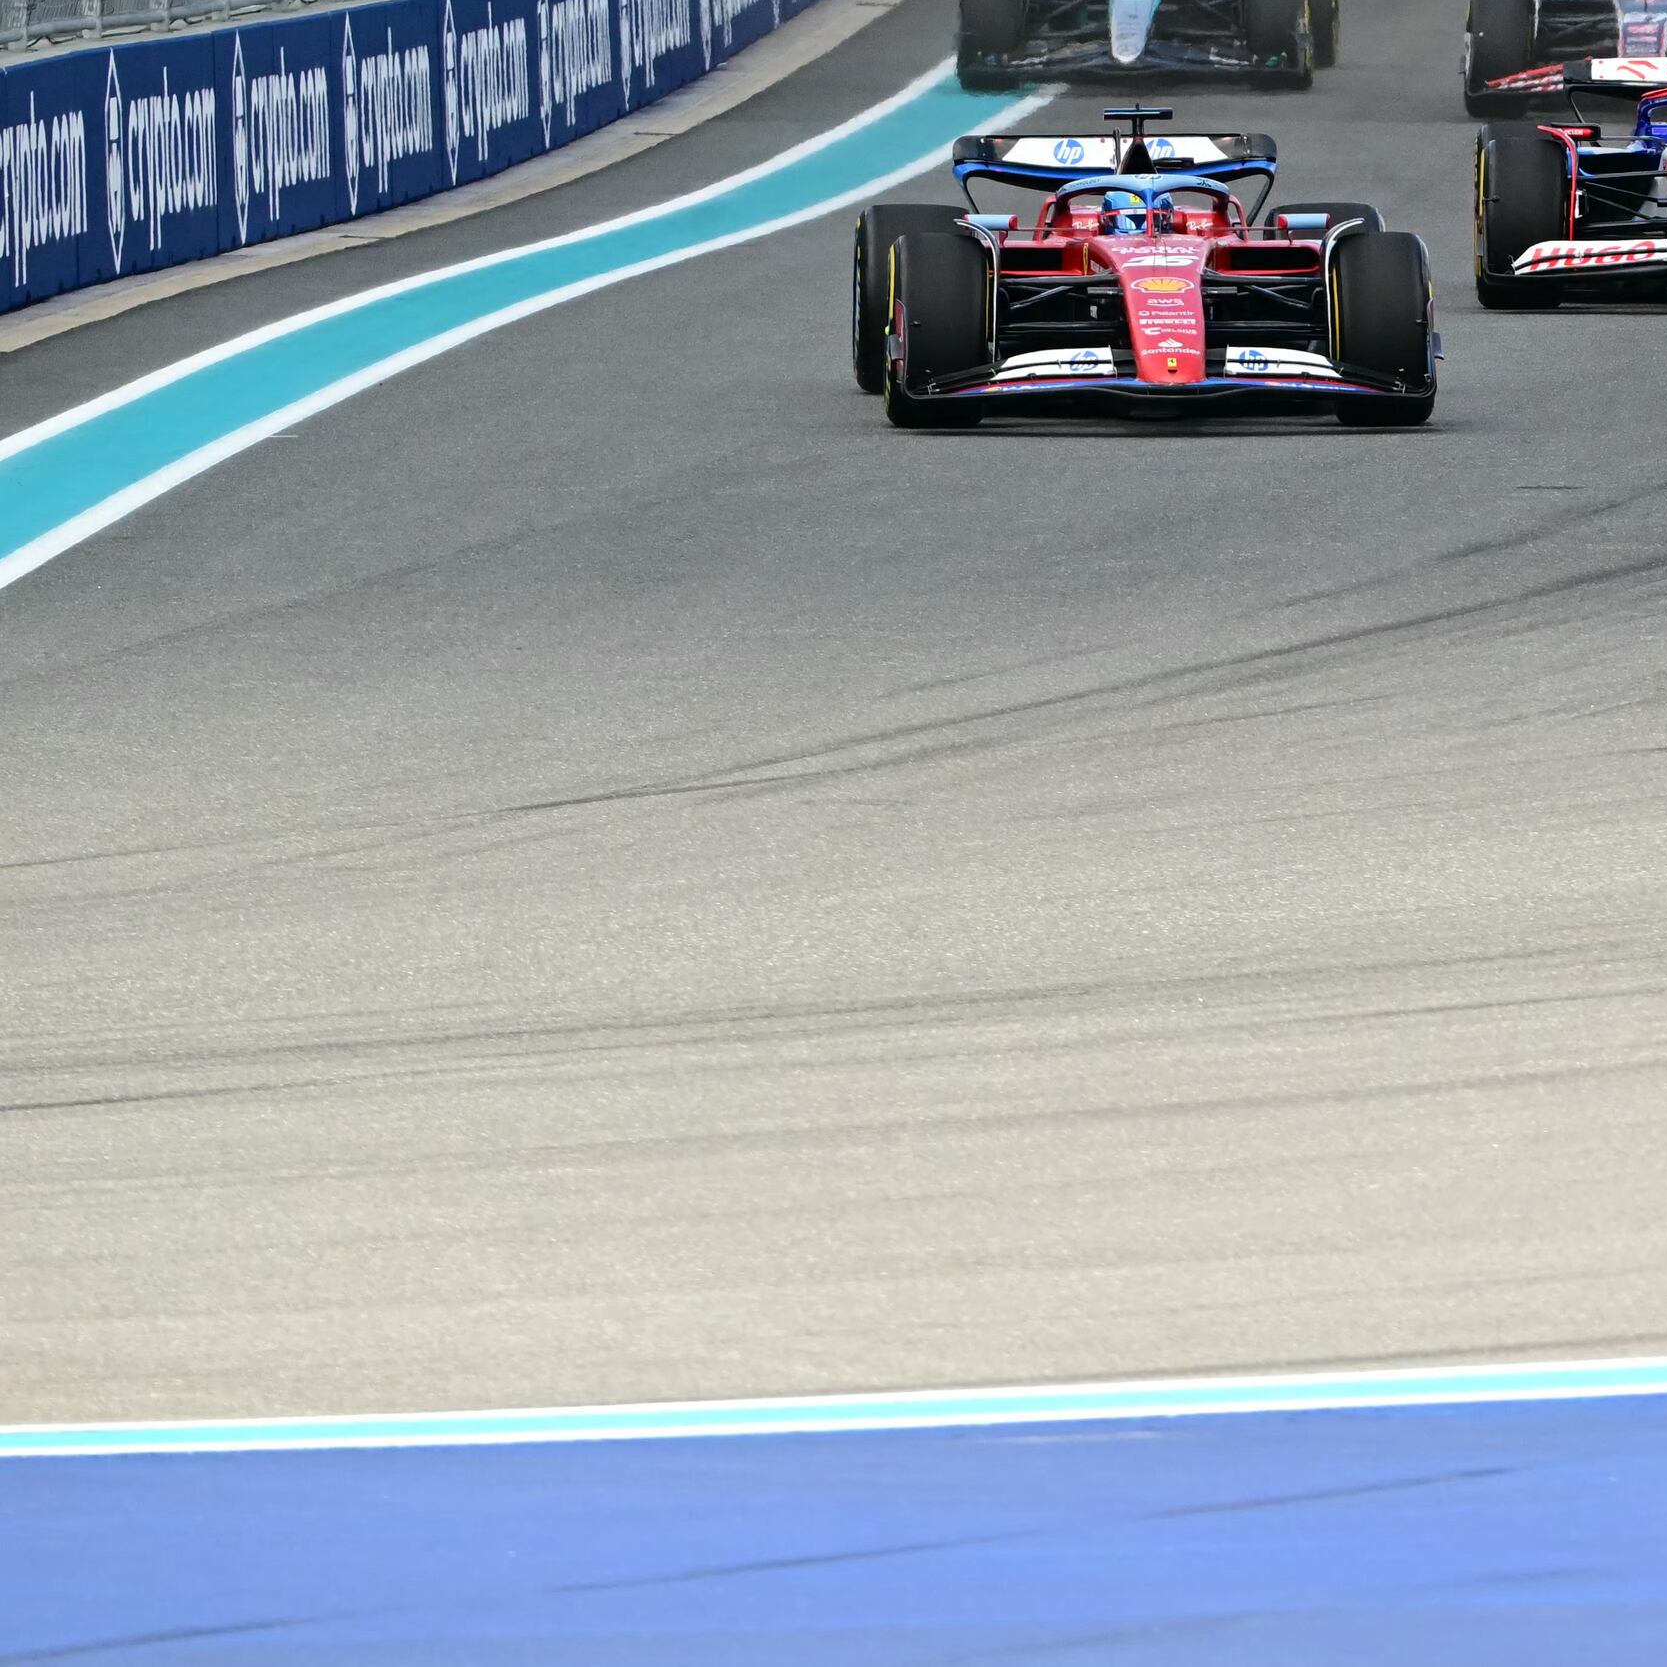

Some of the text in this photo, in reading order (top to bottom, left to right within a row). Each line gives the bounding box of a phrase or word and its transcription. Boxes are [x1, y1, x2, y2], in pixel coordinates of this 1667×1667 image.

[250, 46, 331, 221] crypto.com
[128, 66, 218, 251] crypto.com
[1057, 138, 1083, 165] hp
[1530, 240, 1655, 270] HUGO
[1147, 297, 1184, 306] aws
[1140, 347, 1201, 356] Santander
